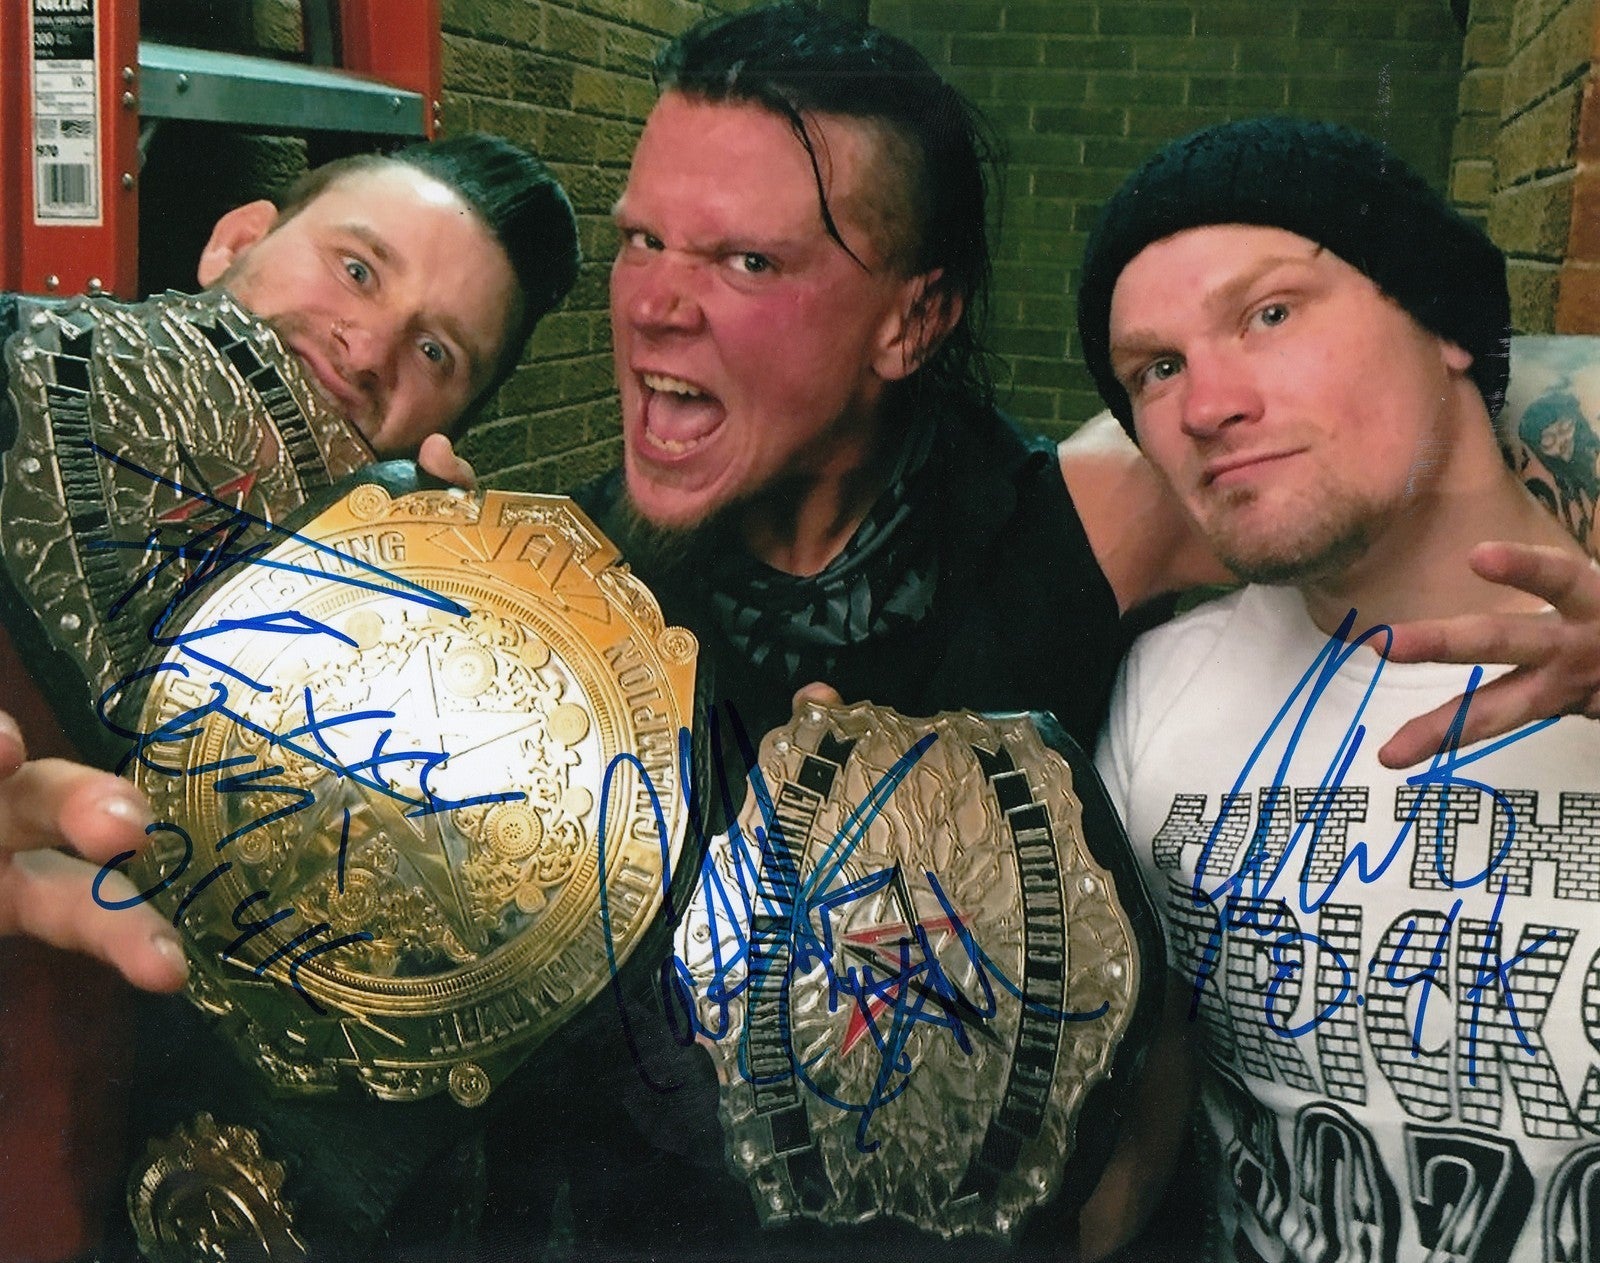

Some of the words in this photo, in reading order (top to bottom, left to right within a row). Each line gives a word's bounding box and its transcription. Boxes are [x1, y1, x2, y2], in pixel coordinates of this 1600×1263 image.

[602, 633, 673, 845] CHAMPION
[1014, 823, 1063, 963] CHAMPION
[1152, 785, 1369, 885] HIT
[1165, 874, 1600, 1141] BRICK
